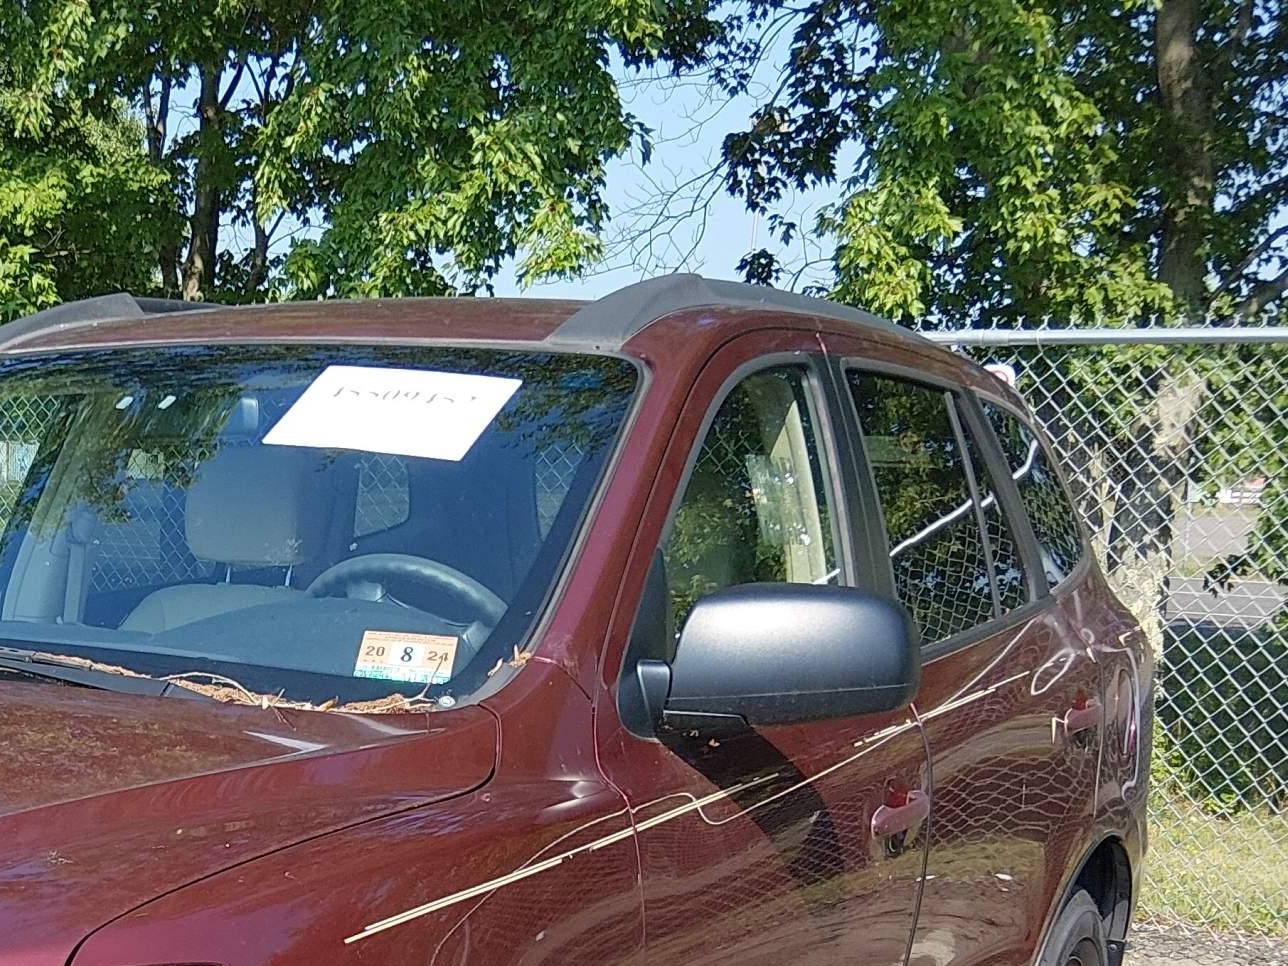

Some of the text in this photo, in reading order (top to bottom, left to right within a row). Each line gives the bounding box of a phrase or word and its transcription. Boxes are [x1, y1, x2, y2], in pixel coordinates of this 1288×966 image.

[365, 645, 450, 663] 20 8 24
